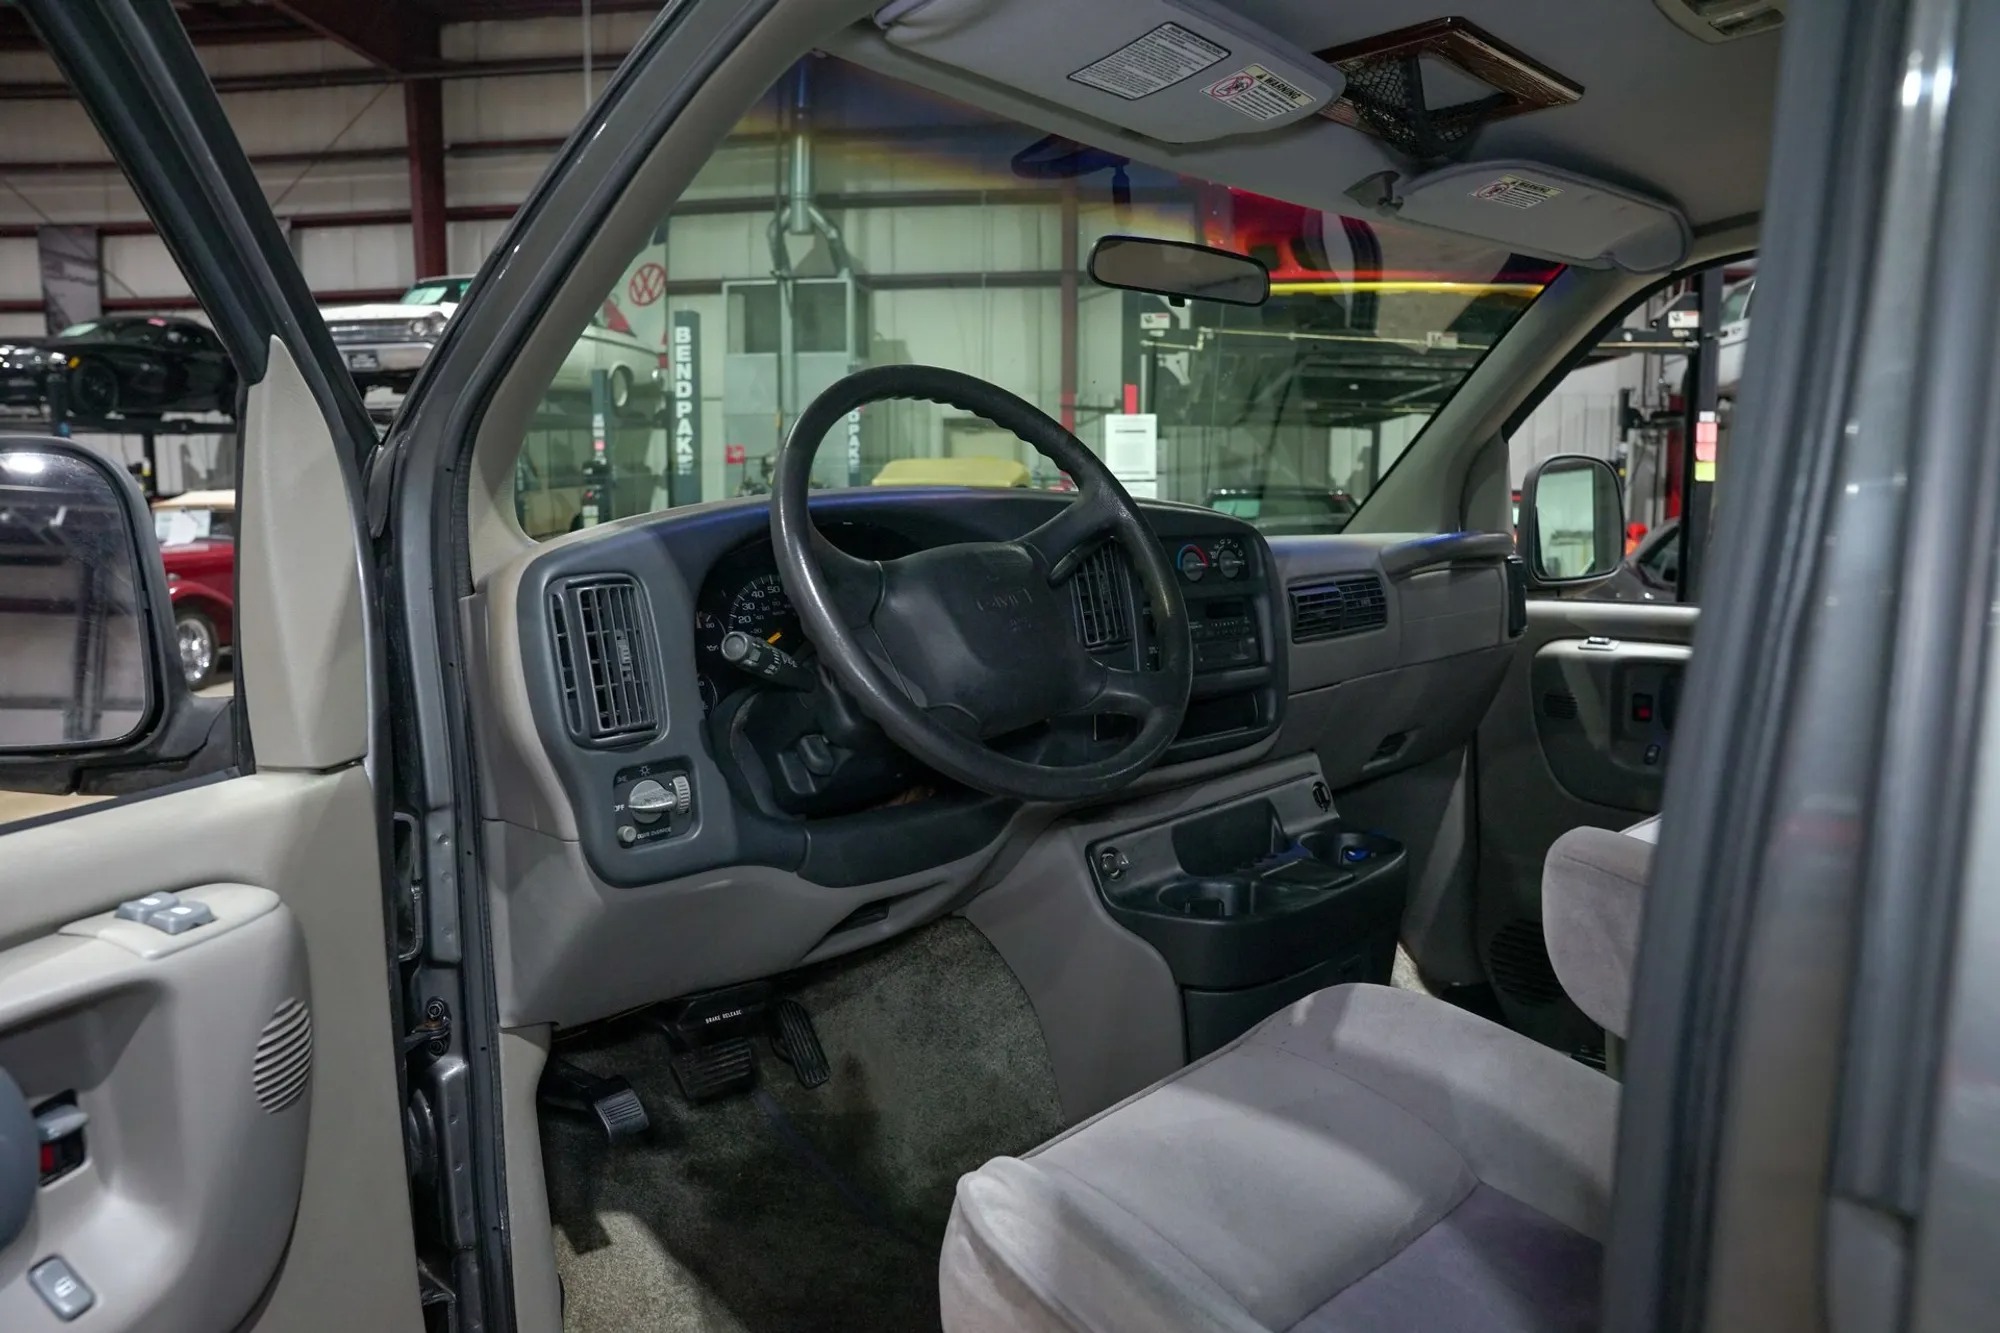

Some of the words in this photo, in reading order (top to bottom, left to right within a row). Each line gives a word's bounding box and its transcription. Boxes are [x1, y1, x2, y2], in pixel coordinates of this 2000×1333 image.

[1264, 76, 1301, 100] WARNING
[675, 326, 693, 454] BENDPAK
[767, 585, 780, 593] 50
[751, 590, 764, 598] 40
[741, 602, 756, 611] 30
[738, 615, 751, 624] 20
[613, 804, 625, 812] OFF
[705, 1015, 721, 1024] BRAKE
[722, 1009, 742, 1019] RELEASE
